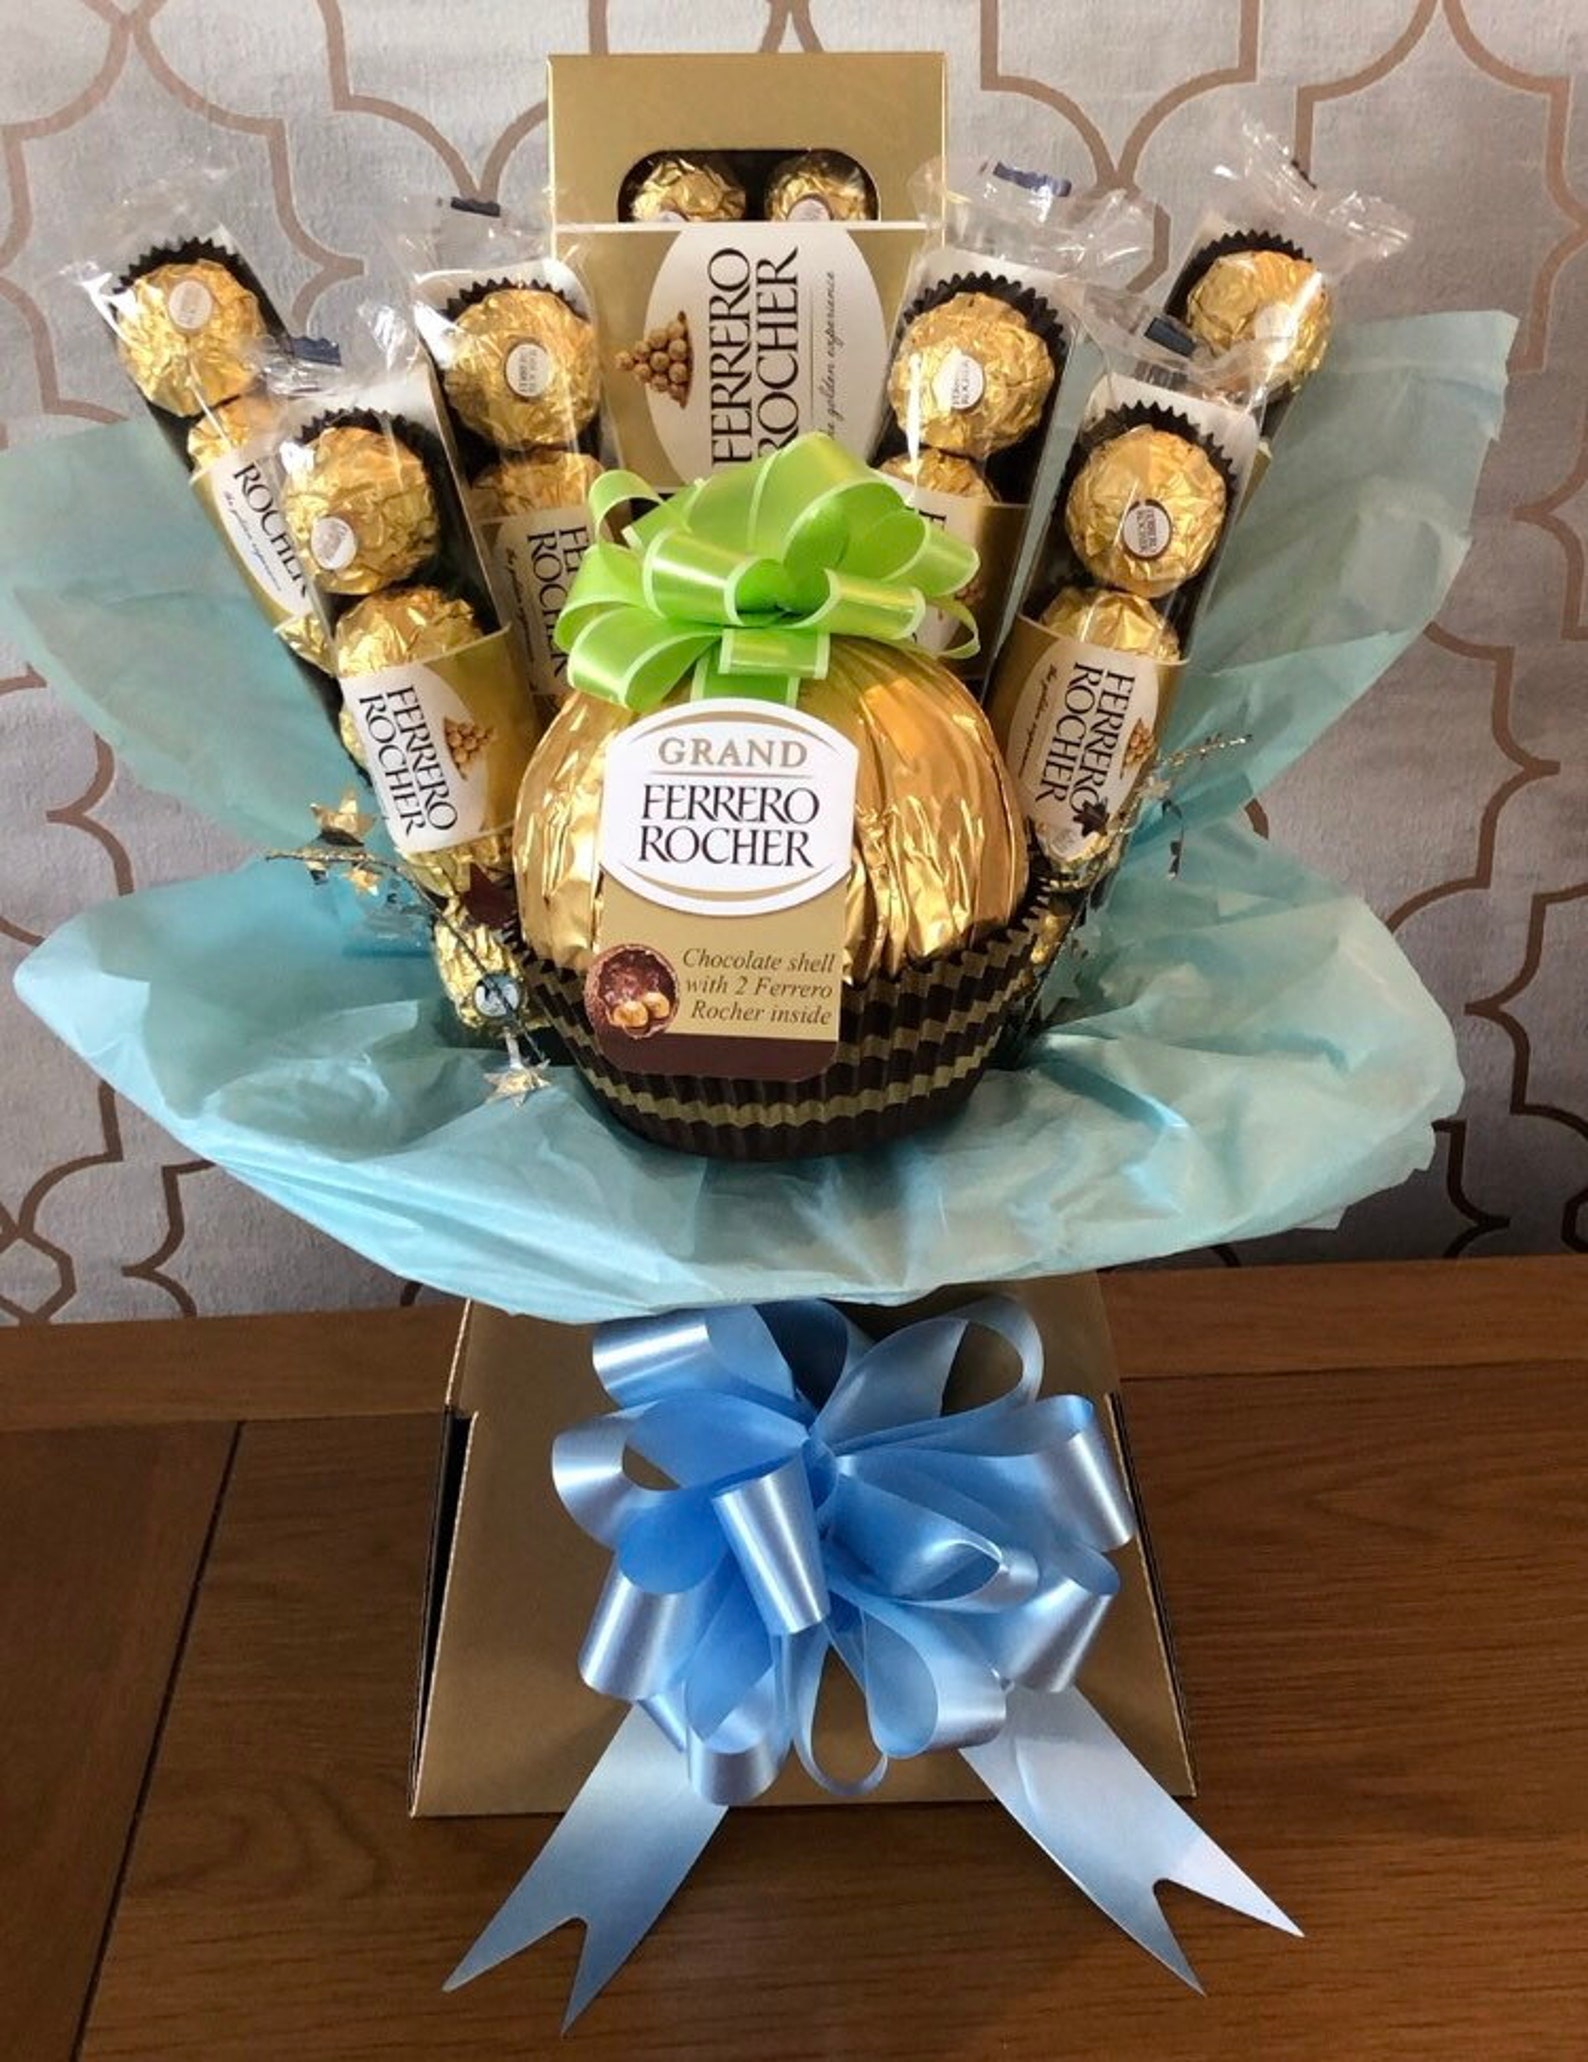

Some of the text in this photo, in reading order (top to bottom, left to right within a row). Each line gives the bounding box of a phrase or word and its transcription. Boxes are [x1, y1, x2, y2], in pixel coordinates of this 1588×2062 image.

[707, 247, 752, 467] FERRERO
[755, 246, 799, 458] ROCHER
[824, 271, 846, 357] experience
[817, 363, 845, 421] golden
[527, 530, 570, 677] ROCR
[359, 694, 426, 837] ROCHER
[386, 685, 458, 830] FERRERO
[658, 738, 808, 768] GRAND
[1035, 662, 1104, 802] ROCHER
[1069, 669, 1136, 814] FERRERO
[638, 825, 815, 869] ROCHER
[642, 783, 820, 825] FERRERO
[682, 947, 836, 974] Chocolate shell
[685, 974, 834, 999] with 2 Ferrero
[690, 999, 833, 1026] Rocher inside
